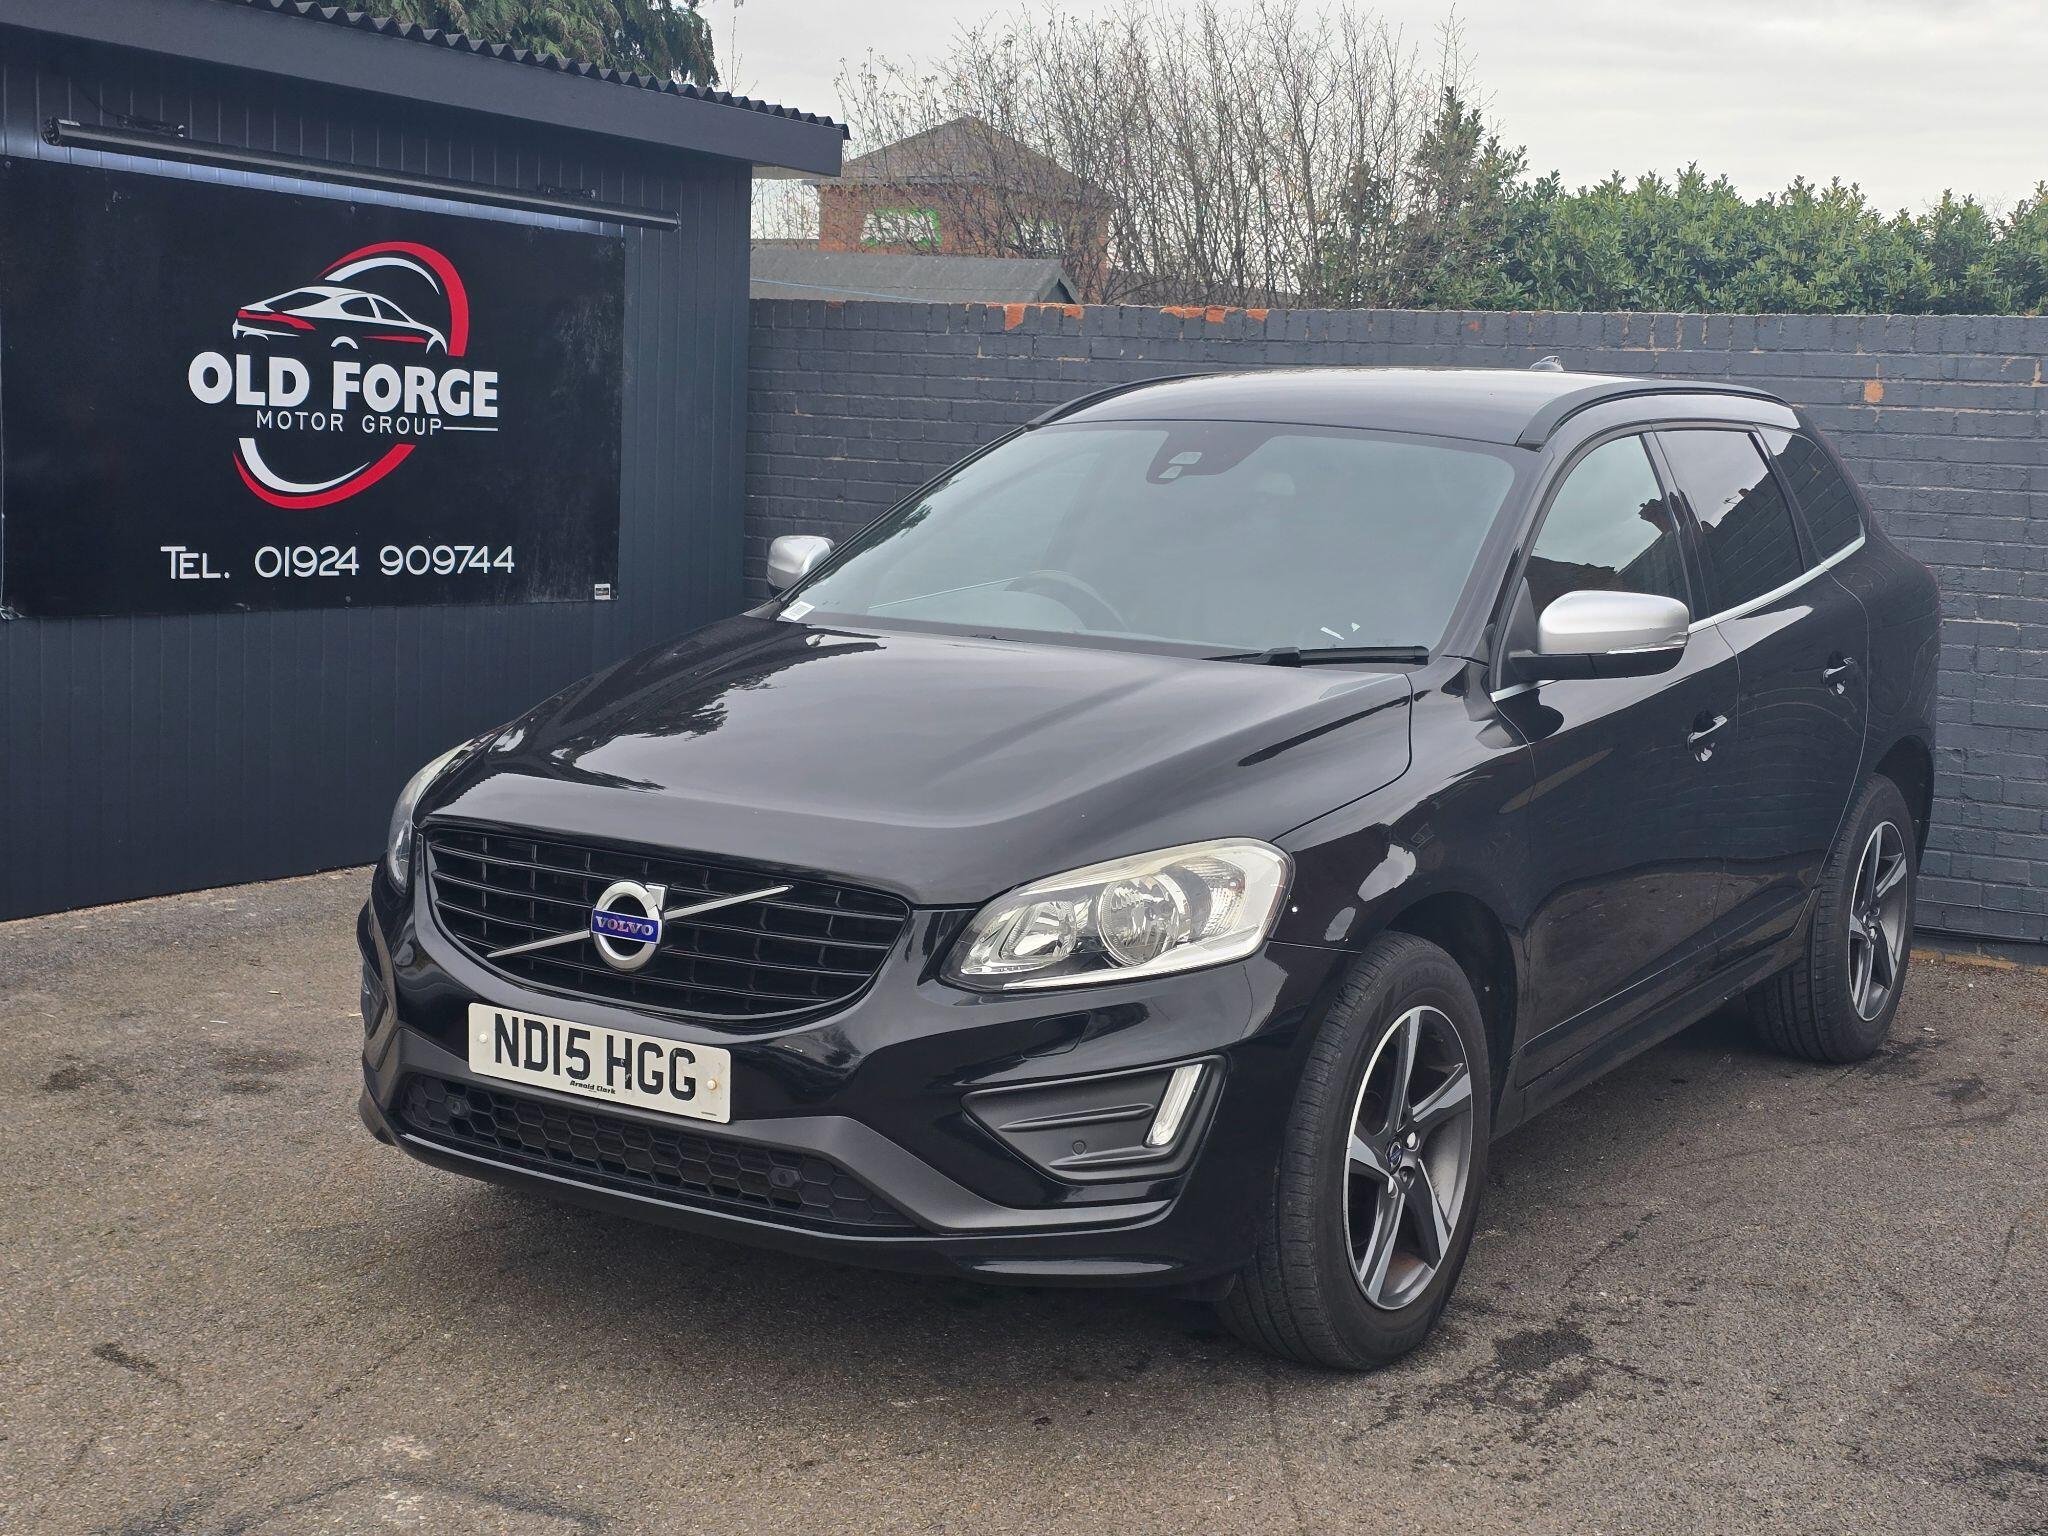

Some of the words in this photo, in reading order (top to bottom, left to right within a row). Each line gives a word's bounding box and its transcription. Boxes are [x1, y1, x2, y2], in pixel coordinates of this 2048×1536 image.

[188, 351, 310, 407] OLD
[332, 360, 498, 418] FORGE
[256, 410, 343, 433] MOTOR
[362, 414, 442, 436] GROUP
[160, 545, 230, 579] TEL.
[254, 545, 360, 578] 01924
[379, 545, 515, 576] 909744
[595, 915, 654, 936] VOLVO
[494, 1013, 591, 1081] ND15
[606, 1034, 696, 1101] HGG
[569, 1080, 595, 1091] Arnold
[596, 1085, 616, 1095] Clark
